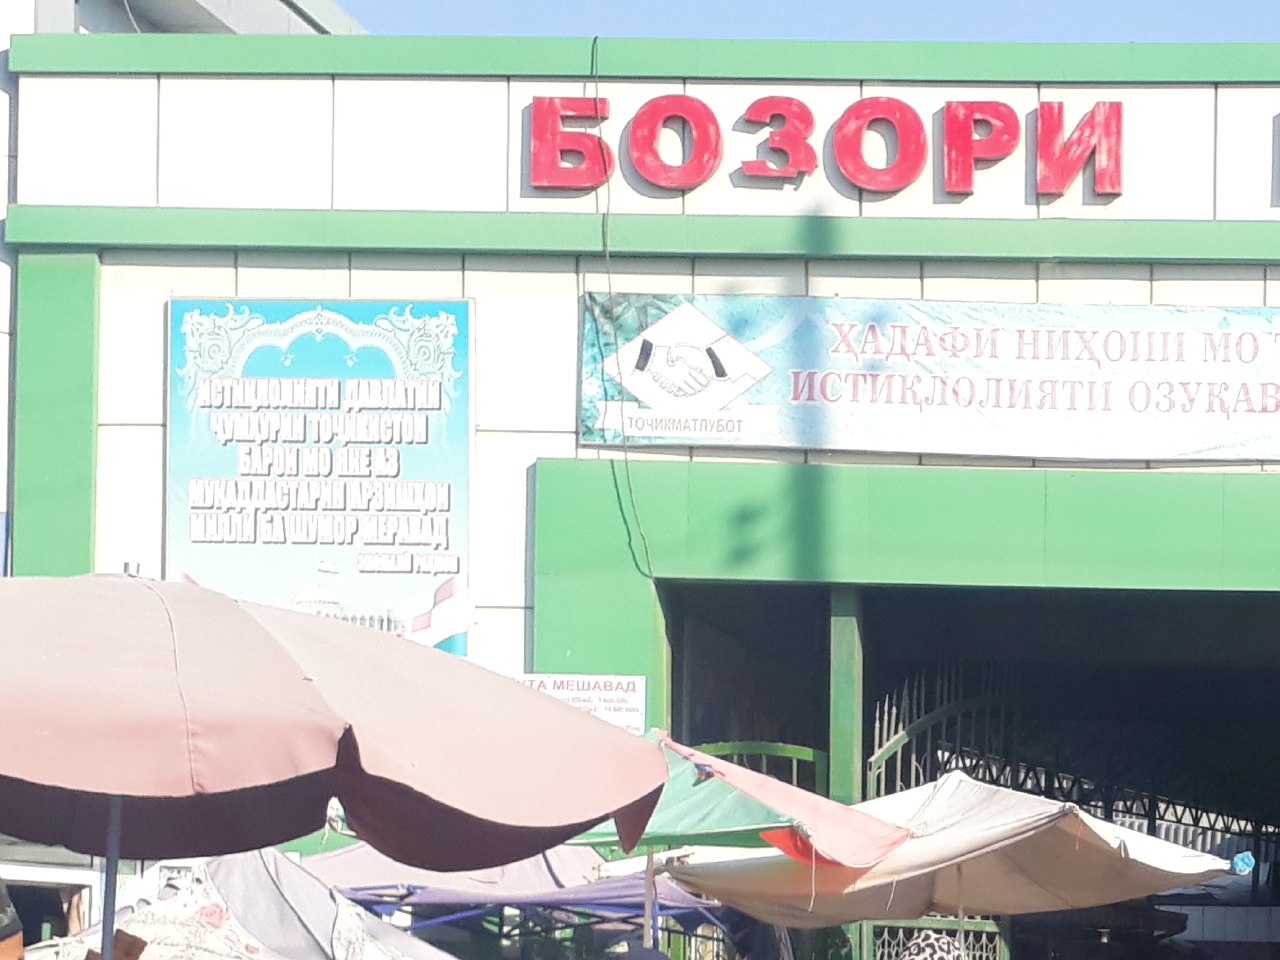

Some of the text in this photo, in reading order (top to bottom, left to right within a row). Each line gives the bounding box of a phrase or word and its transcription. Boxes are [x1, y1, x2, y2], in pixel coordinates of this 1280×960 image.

[530, 94, 1123, 196] БОЗОРИ
[830, 322, 1000, 363] ҲАДАФИ
[1202, 331, 1260, 364] МО
[790, 370, 1113, 413] ИСТИҚЛОЛИЯТИ
[552, 679, 636, 694] МЕШАВАД
